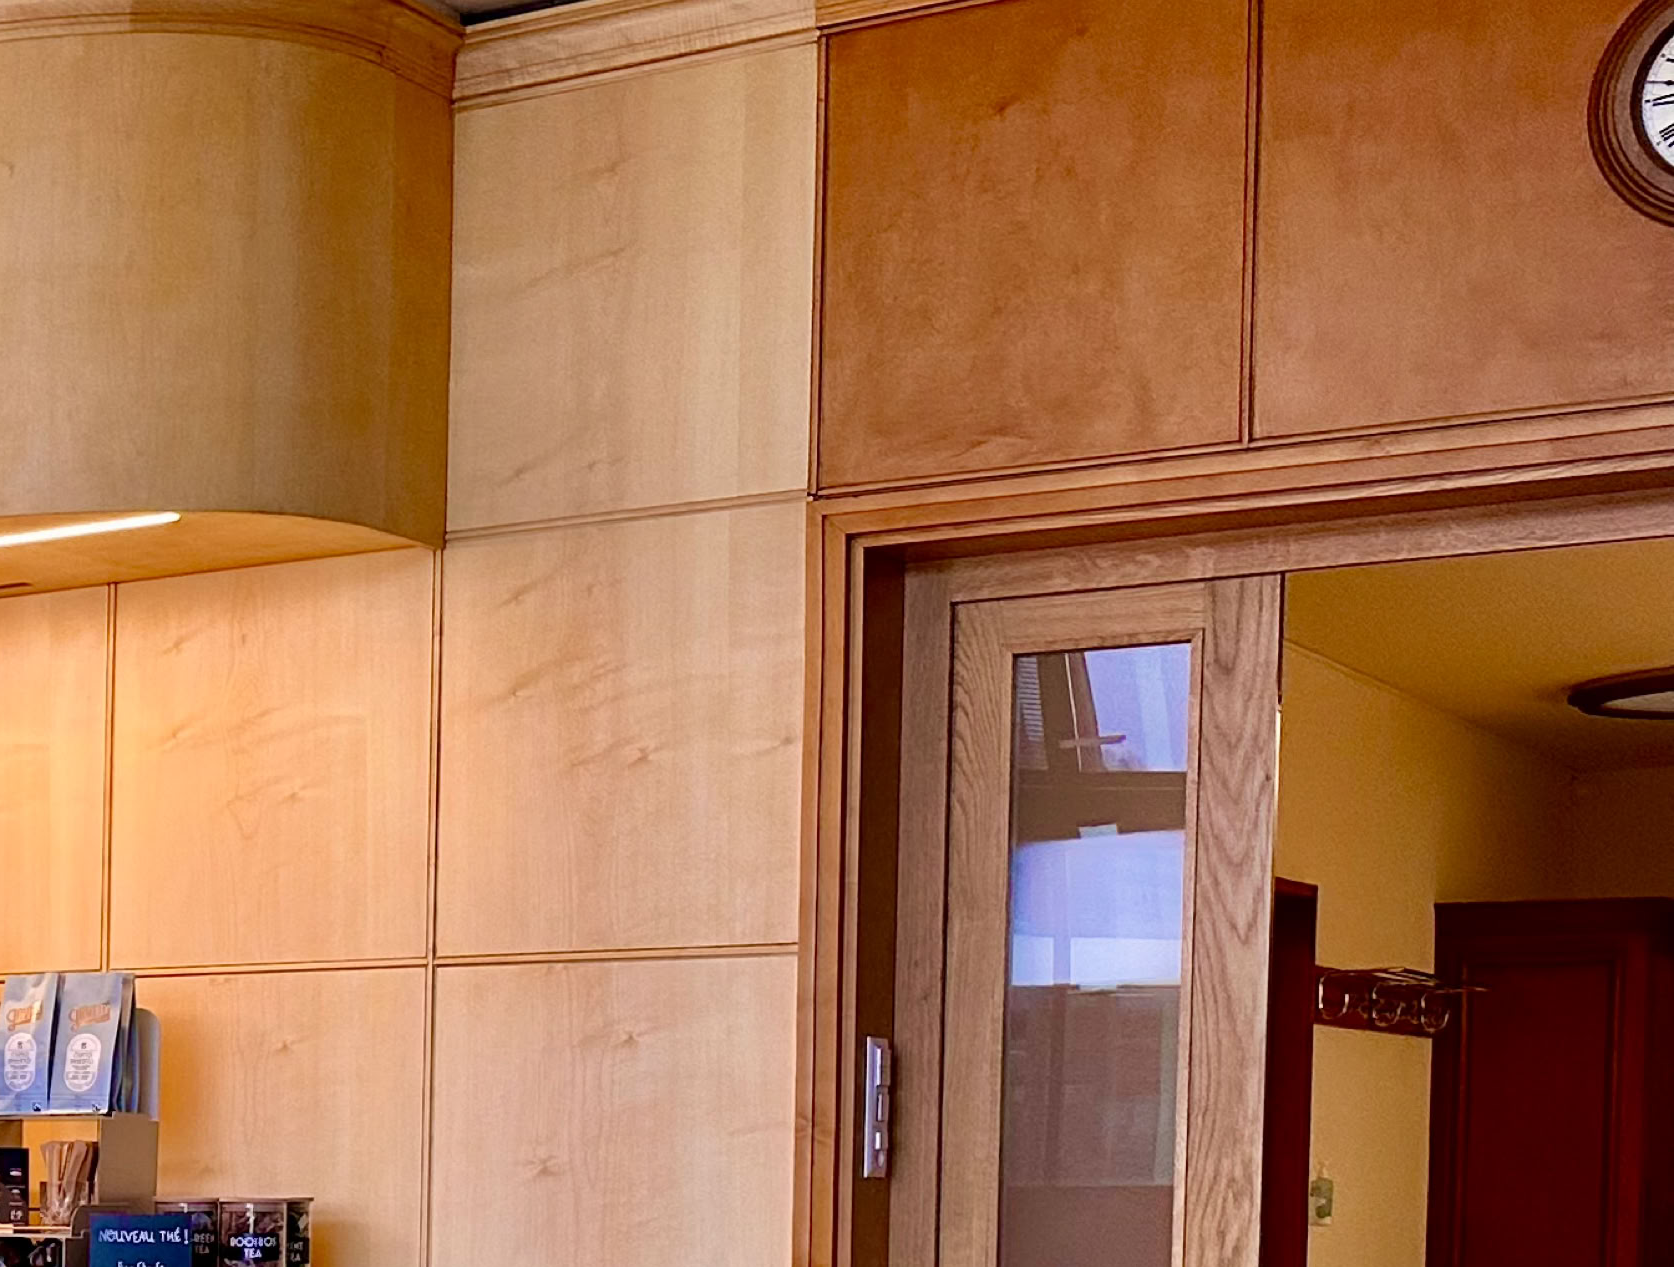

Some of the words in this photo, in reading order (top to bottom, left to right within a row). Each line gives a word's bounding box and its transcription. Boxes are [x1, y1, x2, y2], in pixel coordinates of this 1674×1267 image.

[98, 1229, 155, 1243] NOUVEAU
[159, 1226, 181, 1242] THÉ
[193, 1232, 215, 1244] REEN
[244, 1248, 262, 1258] TEA
